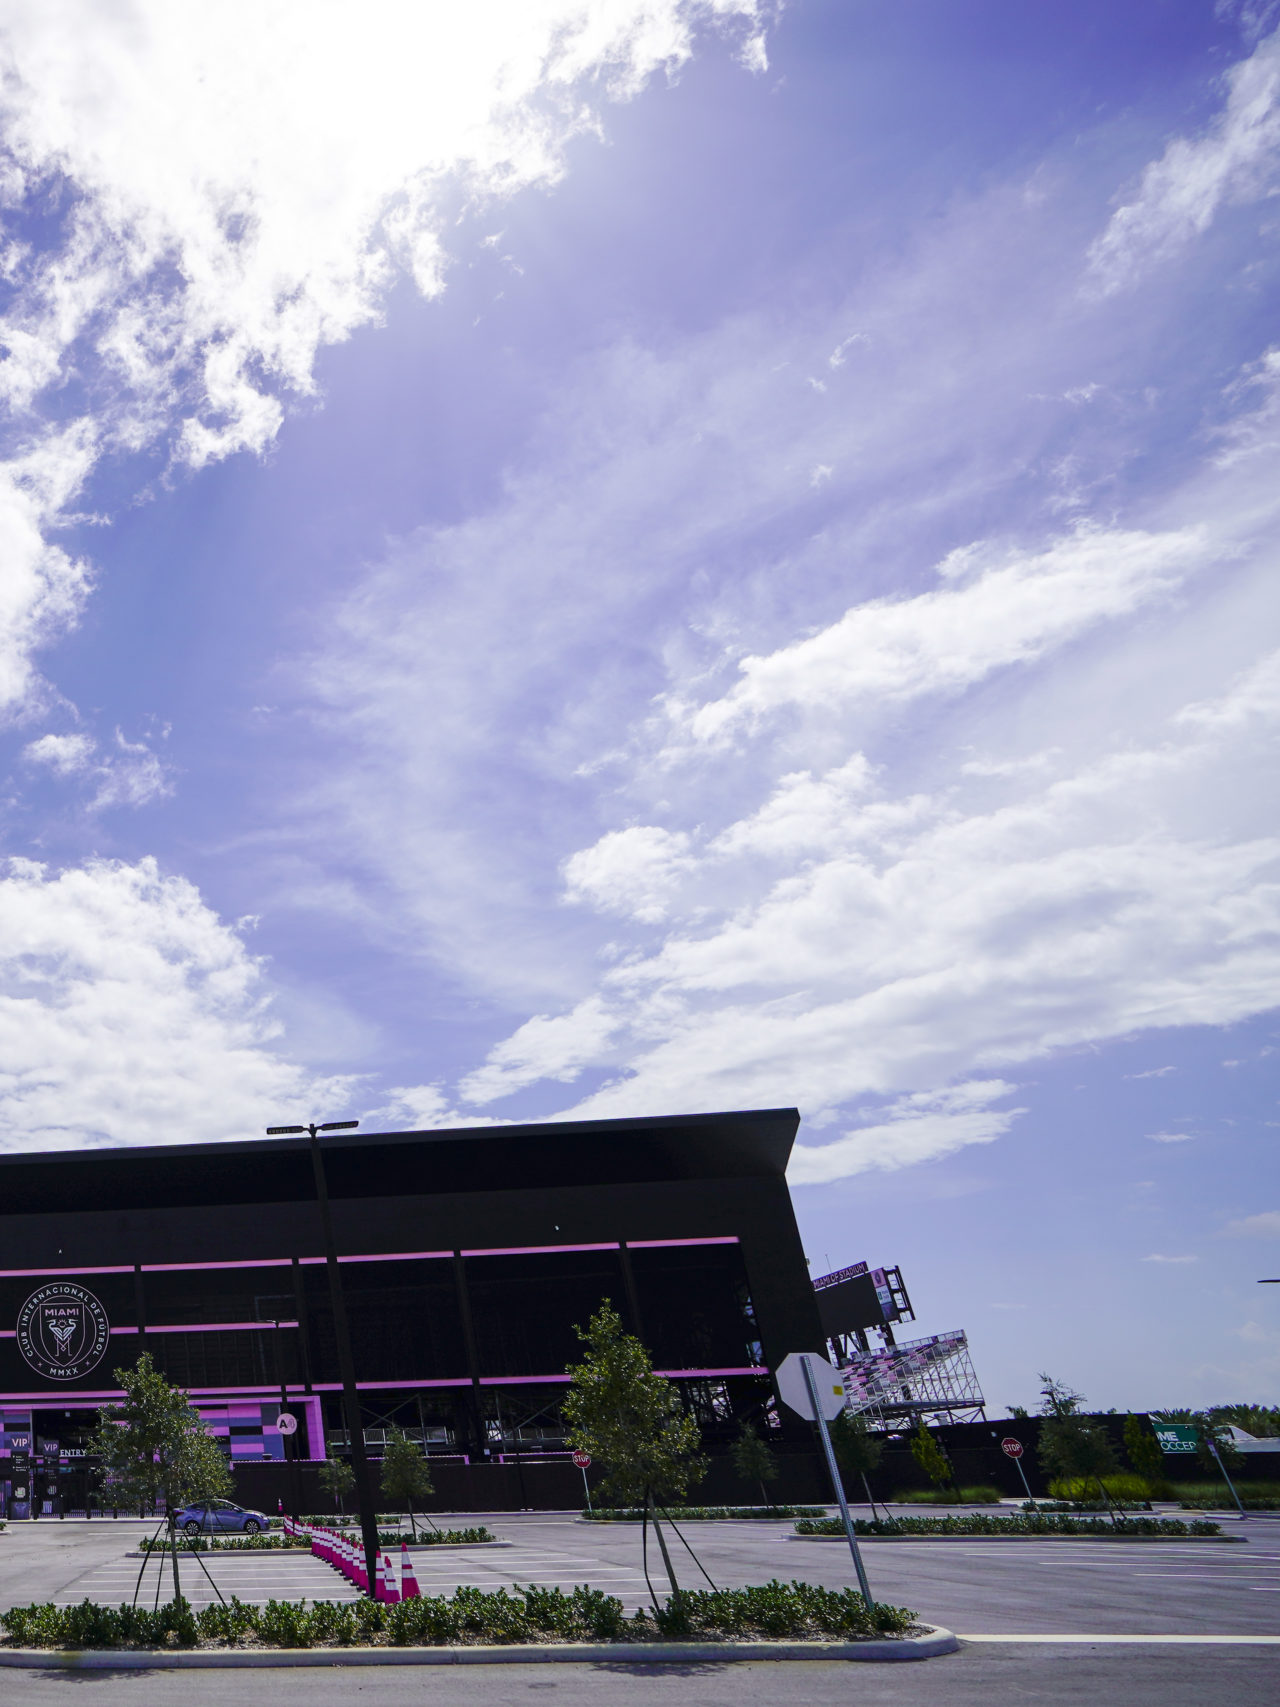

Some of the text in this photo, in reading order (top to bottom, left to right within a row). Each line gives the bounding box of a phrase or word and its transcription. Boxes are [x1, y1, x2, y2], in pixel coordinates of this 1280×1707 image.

[813, 1263, 866, 1289] MIAMI CF STADIUM
[45, 1308, 79, 1317] MIAMI
[20, 1286, 107, 1357] CLUB INTERNACIONAL DE FÚTBOL
[49, 1367, 79, 1376] MMXX
[1155, 1431, 1179, 1441] ME
[11, 1438, 28, 1447] VIP
[44, 1443, 58, 1452] VIP
[1003, 1443, 1020, 1452] STOP
[59, 1448, 87, 1457] ENTRY
[573, 1455, 589, 1463] STOP
